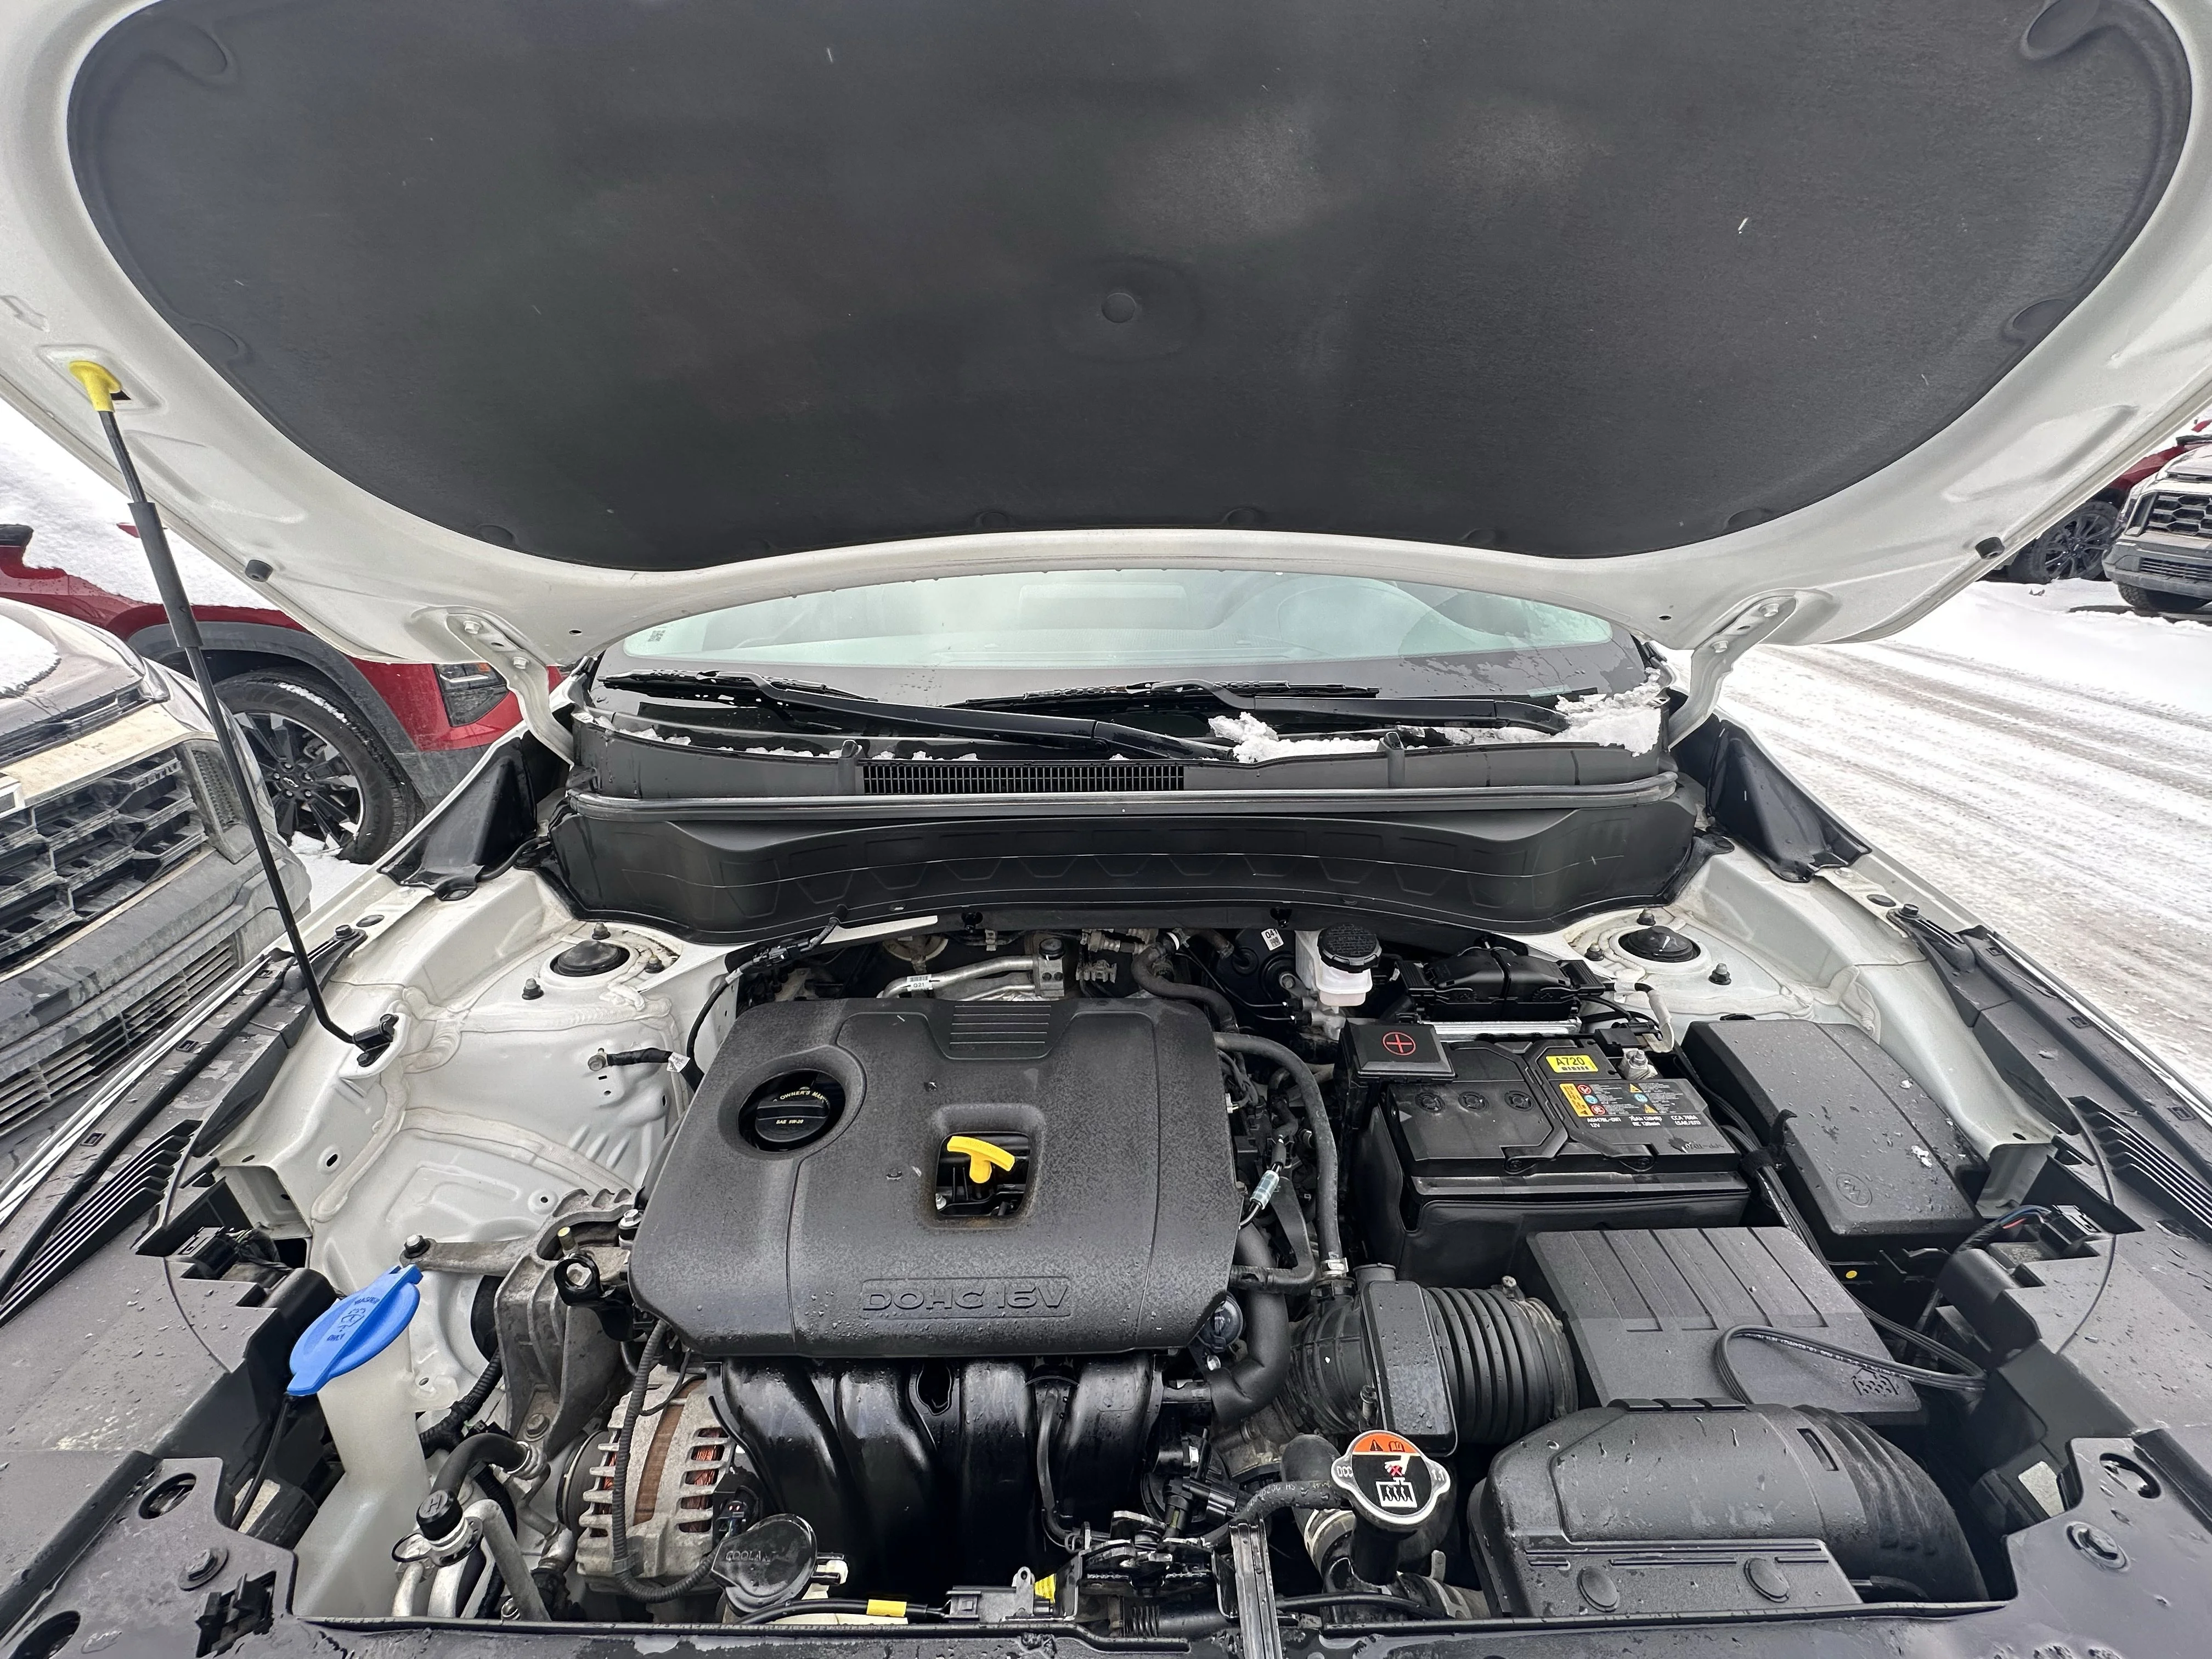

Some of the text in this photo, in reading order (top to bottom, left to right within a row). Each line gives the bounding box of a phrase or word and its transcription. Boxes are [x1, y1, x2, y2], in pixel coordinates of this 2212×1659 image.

[1556, 1057, 1585, 1065] A720
[780, 1091, 811, 1099] OWNER'S
[863, 1285, 1068, 1310] DOHC 16V
[1431, 1469, 1444, 1481] 1.1
